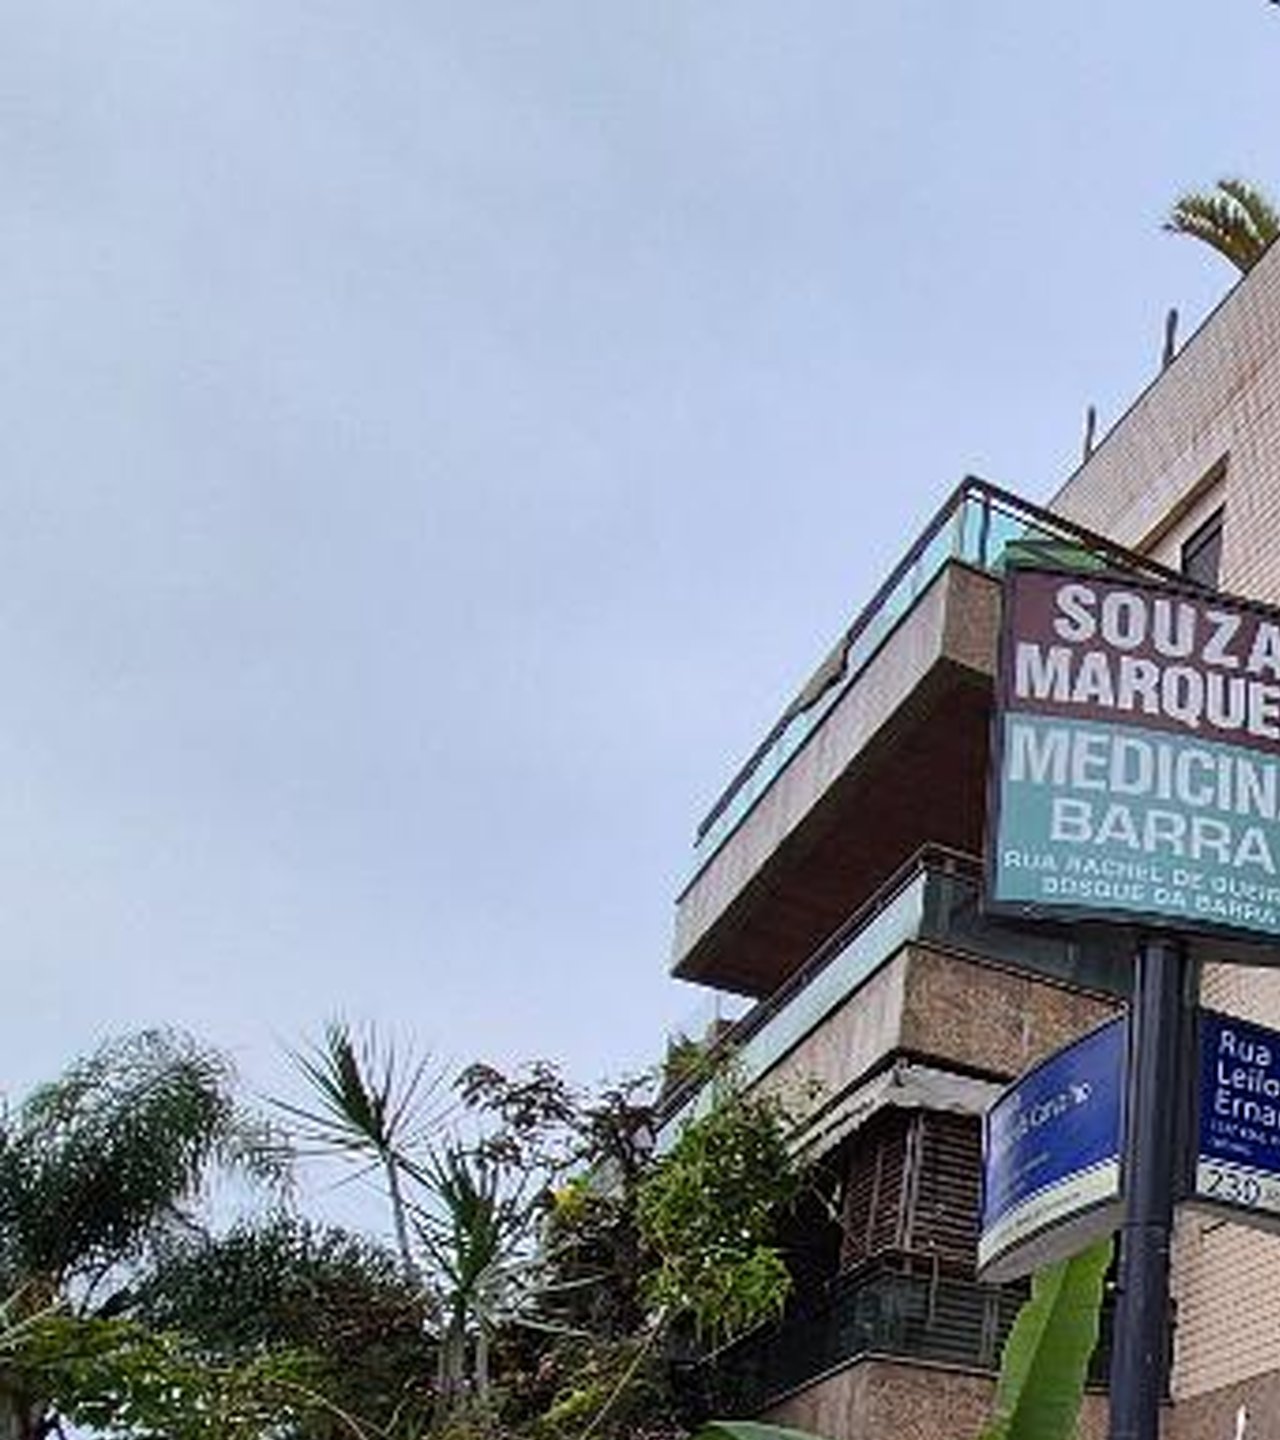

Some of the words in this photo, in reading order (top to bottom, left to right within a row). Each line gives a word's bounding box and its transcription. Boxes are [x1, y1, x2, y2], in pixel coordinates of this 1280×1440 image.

[1050, 798, 1276, 874] BARRA
[1004, 851, 1058, 871] RUA
[1064, 854, 1163, 883] RACHEL
[1173, 869, 1204, 889] DE
[1042, 877, 1145, 901] BOSQUE
[1154, 889, 1186, 907] DA
[1195, 896, 1278, 925] BARRA
[1218, 1030, 1272, 1066] Rua
